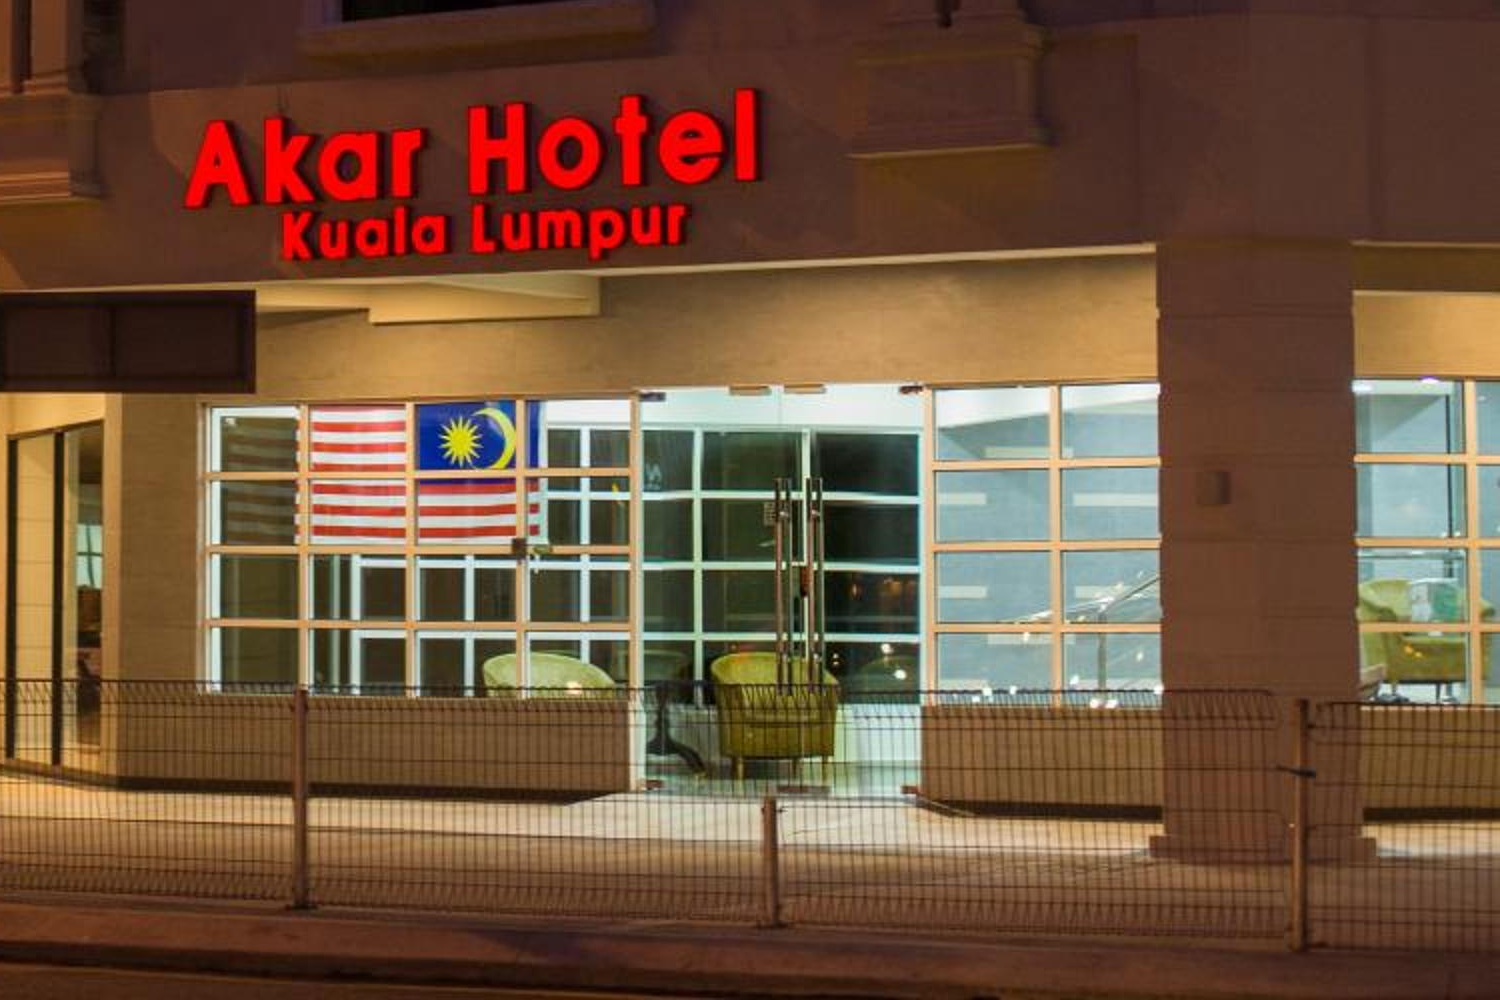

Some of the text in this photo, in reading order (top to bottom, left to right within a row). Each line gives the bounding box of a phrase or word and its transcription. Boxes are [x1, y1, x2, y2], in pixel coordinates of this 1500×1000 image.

[185, 89, 755, 208] Akar Hotel
[281, 203, 687, 261] Kuala Lumpur
